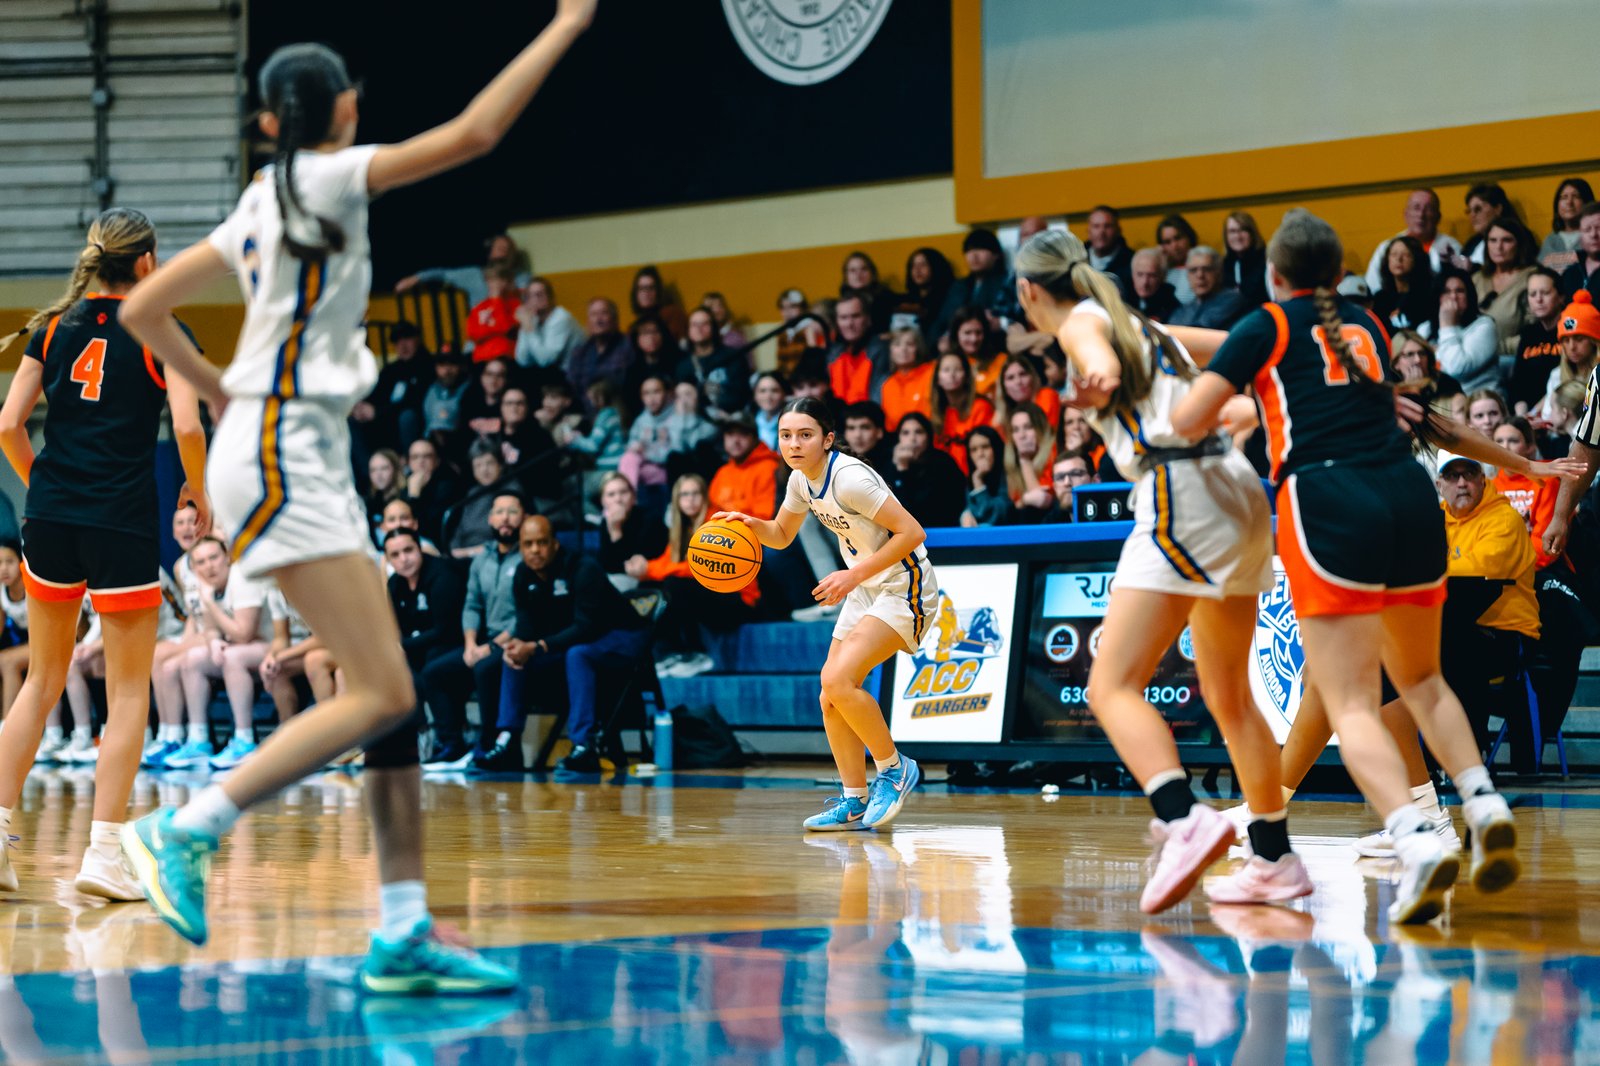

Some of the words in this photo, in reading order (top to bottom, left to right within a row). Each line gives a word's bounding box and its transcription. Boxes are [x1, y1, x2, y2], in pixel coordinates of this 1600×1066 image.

[71, 338, 107, 401] 4
[700, 533, 736, 549] NCAA
[692, 553, 736, 574] Wilson
[907, 660, 979, 696] ACC
[1260, 652, 1287, 707] AURORA
[912, 694, 991, 717] CHARGERS
